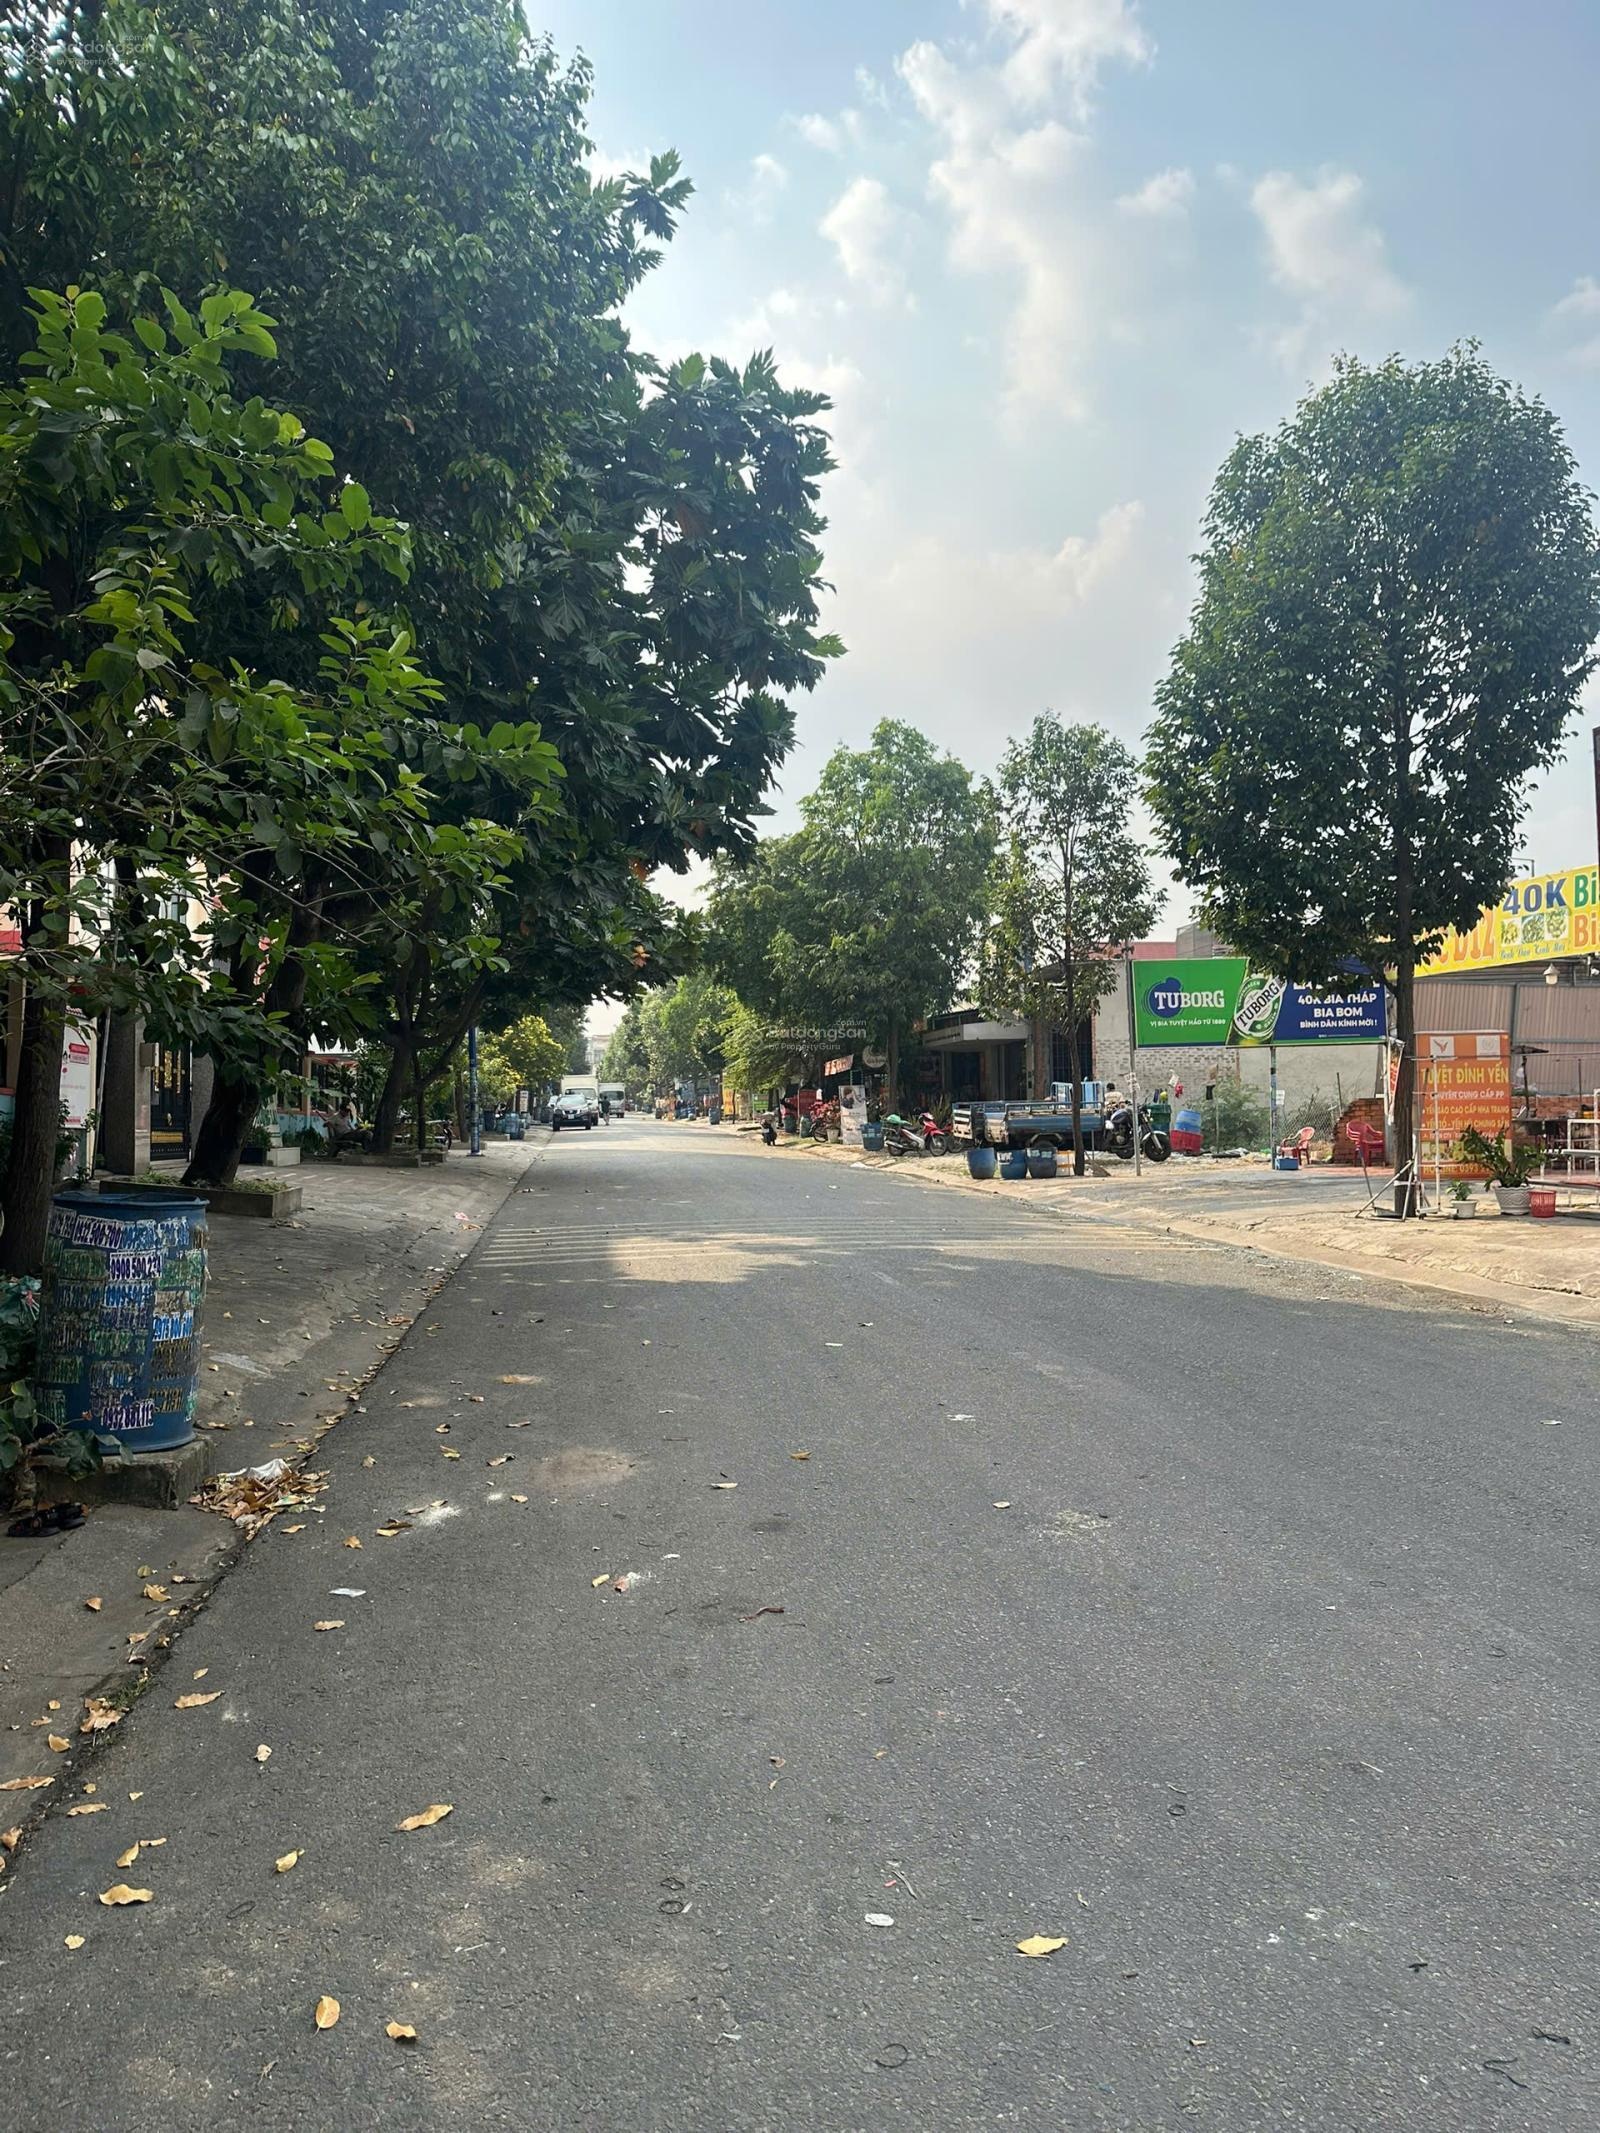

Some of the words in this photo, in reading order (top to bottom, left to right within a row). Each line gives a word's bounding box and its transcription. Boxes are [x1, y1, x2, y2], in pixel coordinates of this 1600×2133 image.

[1502, 878, 1567, 915] 40K
[1574, 871, 1600, 908] Bi
[1574, 912, 1600, 947] Bi
[1154, 990, 1225, 1010] TUBORG
[1237, 982, 1279, 1027] TUBORG
[1314, 1008, 1334, 1018] BIA
[1336, 1007, 1363, 1017] BOM
[1300, 1020, 1320, 1029] BÌNH
[1320, 1019, 1338, 1028] DÂN
[1338, 1018, 1358, 1028] KÍNH
[1488, 1061, 1509, 1084] YẾN
